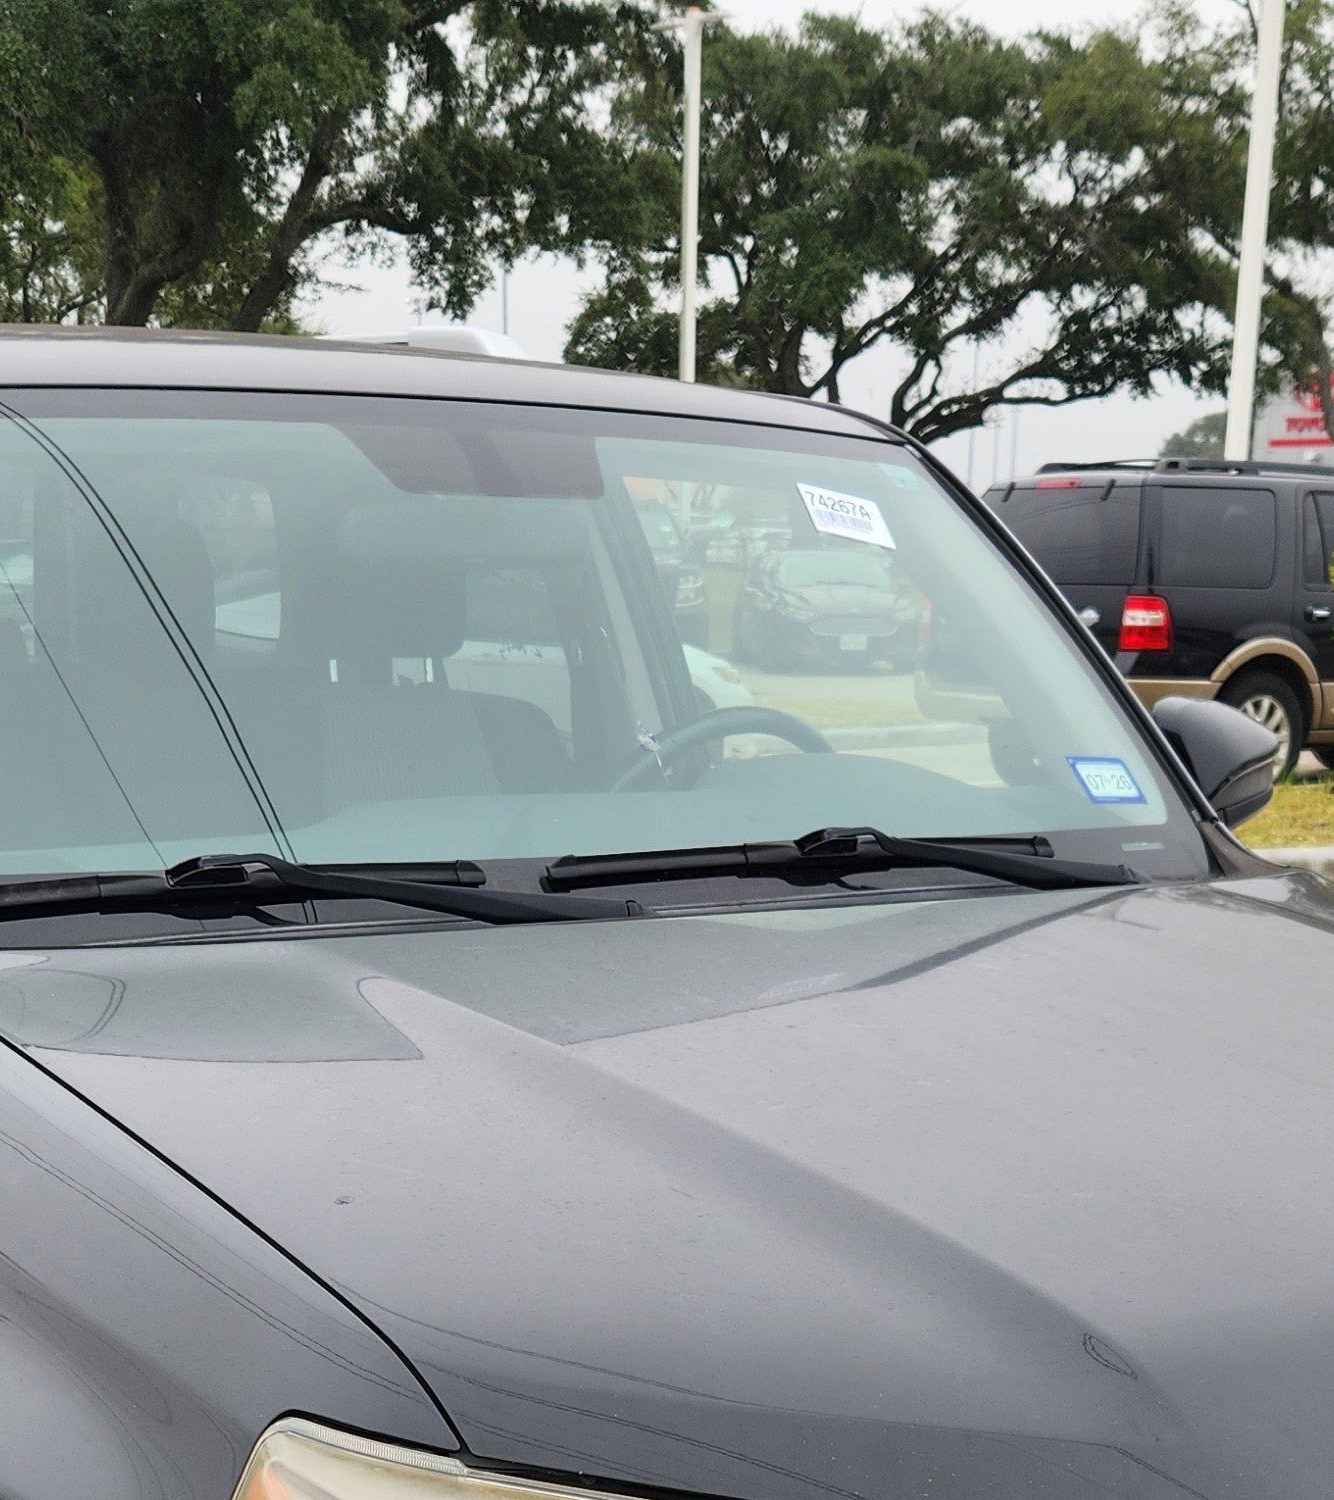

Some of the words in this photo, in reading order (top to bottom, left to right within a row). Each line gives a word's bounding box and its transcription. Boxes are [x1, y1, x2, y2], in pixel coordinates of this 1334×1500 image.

[804, 491, 872, 520] 74267A
[1086, 774, 1106, 790] 07
[1111, 774, 1133, 790] 26
